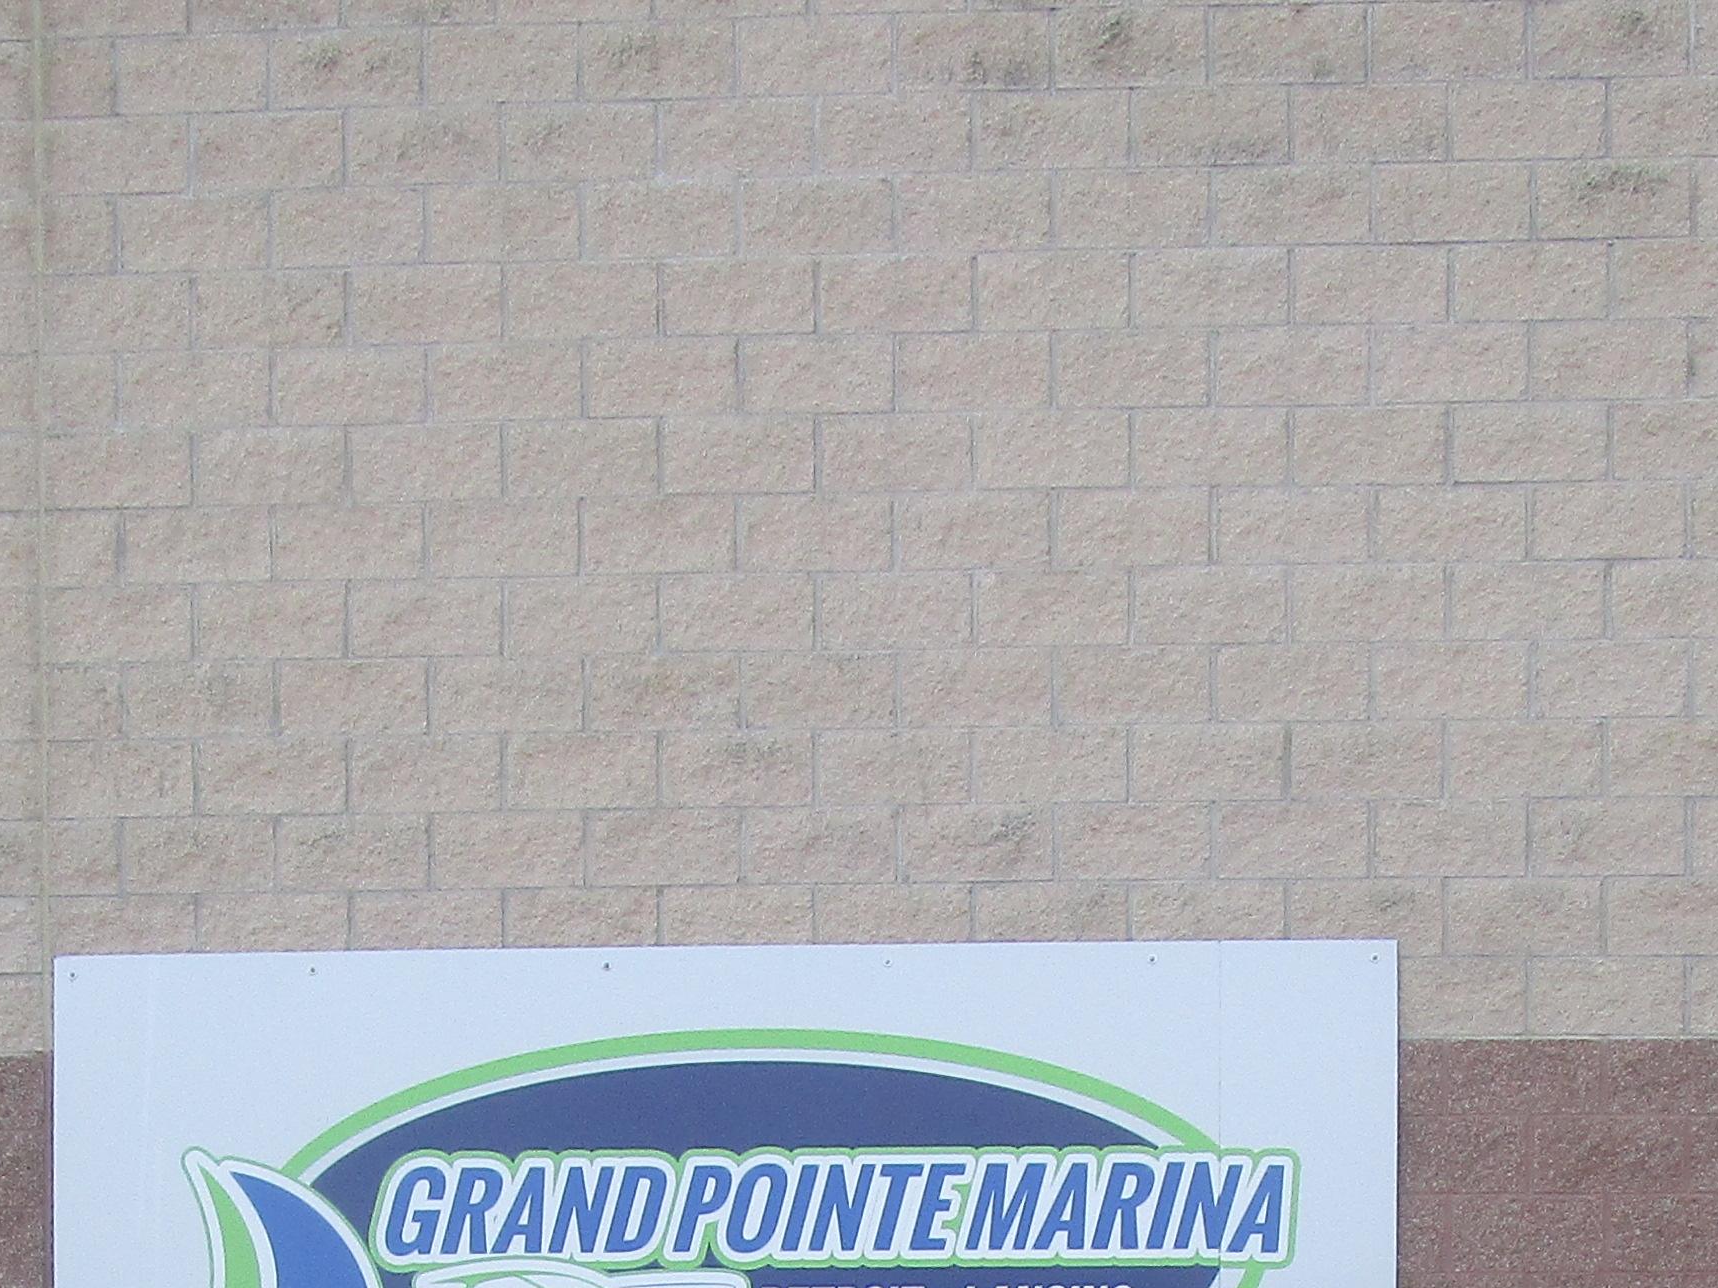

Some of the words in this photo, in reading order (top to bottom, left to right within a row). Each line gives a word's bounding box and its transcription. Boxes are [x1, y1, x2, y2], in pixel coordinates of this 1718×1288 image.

[384, 1164, 668, 1257] GRAND
[673, 1162, 966, 1255] POINTE
[964, 1161, 1286, 1254] MARINA
